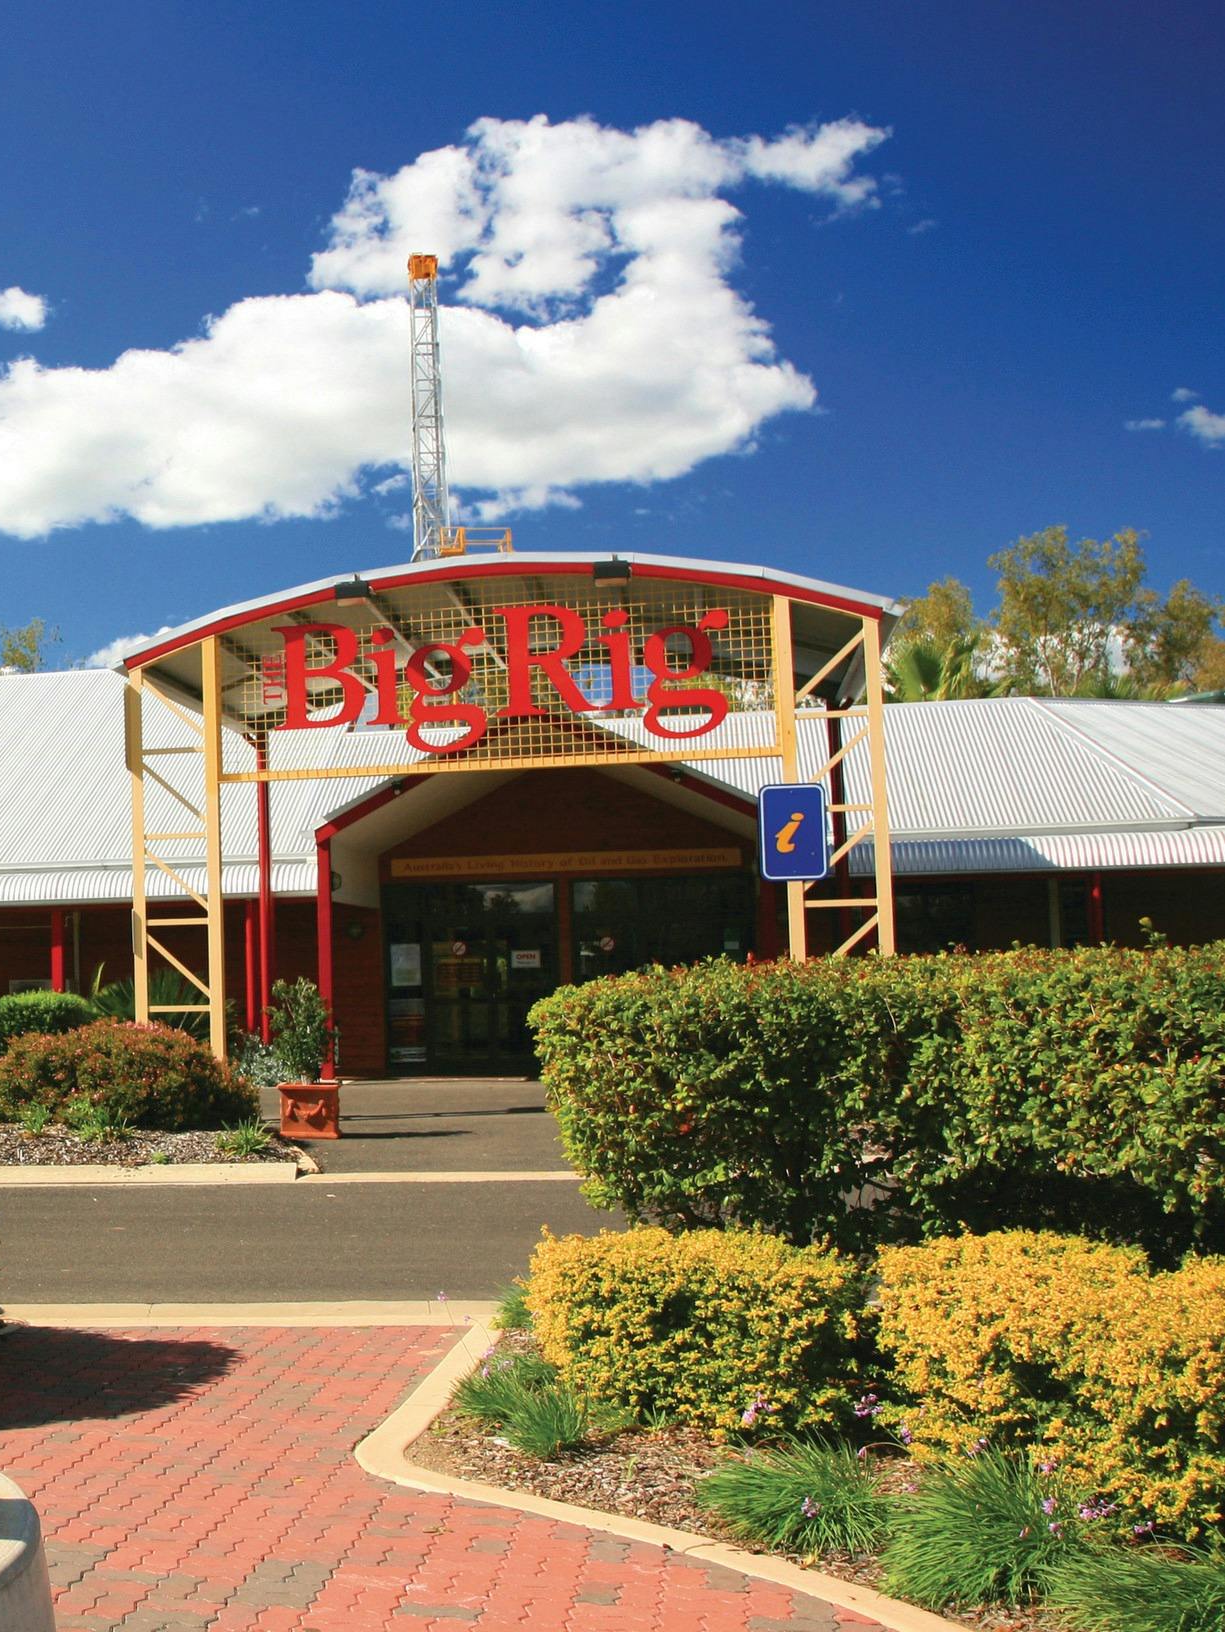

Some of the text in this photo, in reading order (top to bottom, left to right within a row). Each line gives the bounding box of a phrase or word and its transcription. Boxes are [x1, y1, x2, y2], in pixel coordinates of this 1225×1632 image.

[262, 655, 283, 705] THE
[271, 604, 729, 754] Big Rig
